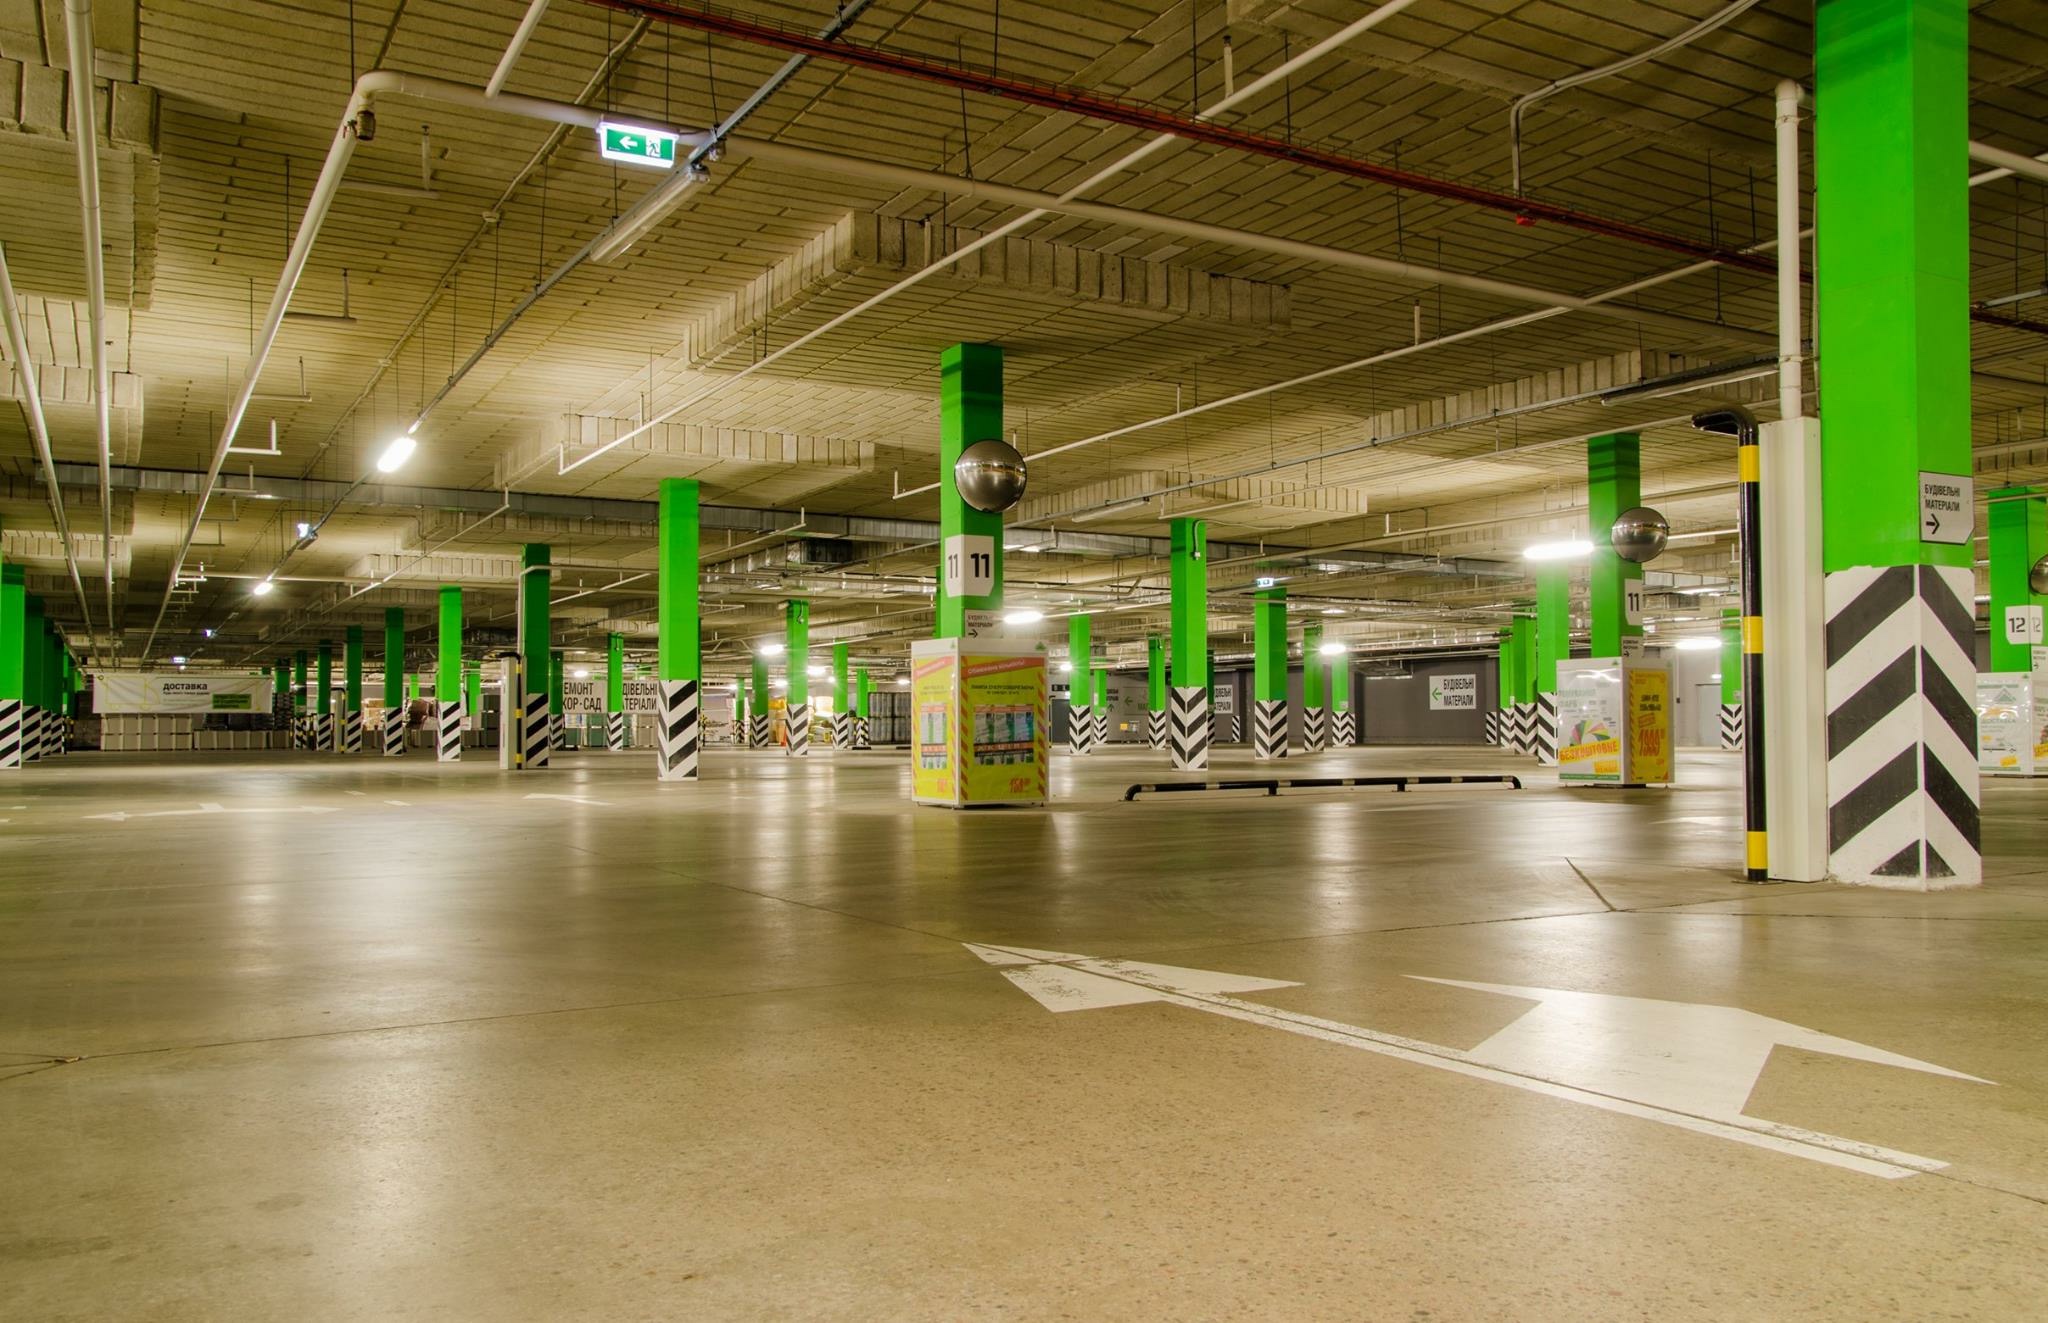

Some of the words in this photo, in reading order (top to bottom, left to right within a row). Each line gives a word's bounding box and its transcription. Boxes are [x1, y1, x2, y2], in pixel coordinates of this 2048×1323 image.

[1924, 484, 1960, 498] БУДІВЕЛЬНІ
[1925, 499, 1960, 512] МАТЕРІАЛИ
[948, 552, 958, 579] 11
[970, 552, 989, 578] 11
[1627, 592, 1640, 612] 11
[2008, 617, 2026, 633] 12
[2032, 617, 2041, 633] 12
[163, 682, 208, 691] доставка
[1443, 678, 1474, 692] БУДІВЕЛЬНІ
[1443, 695, 1474, 706] МАТЕРІАЛИ
